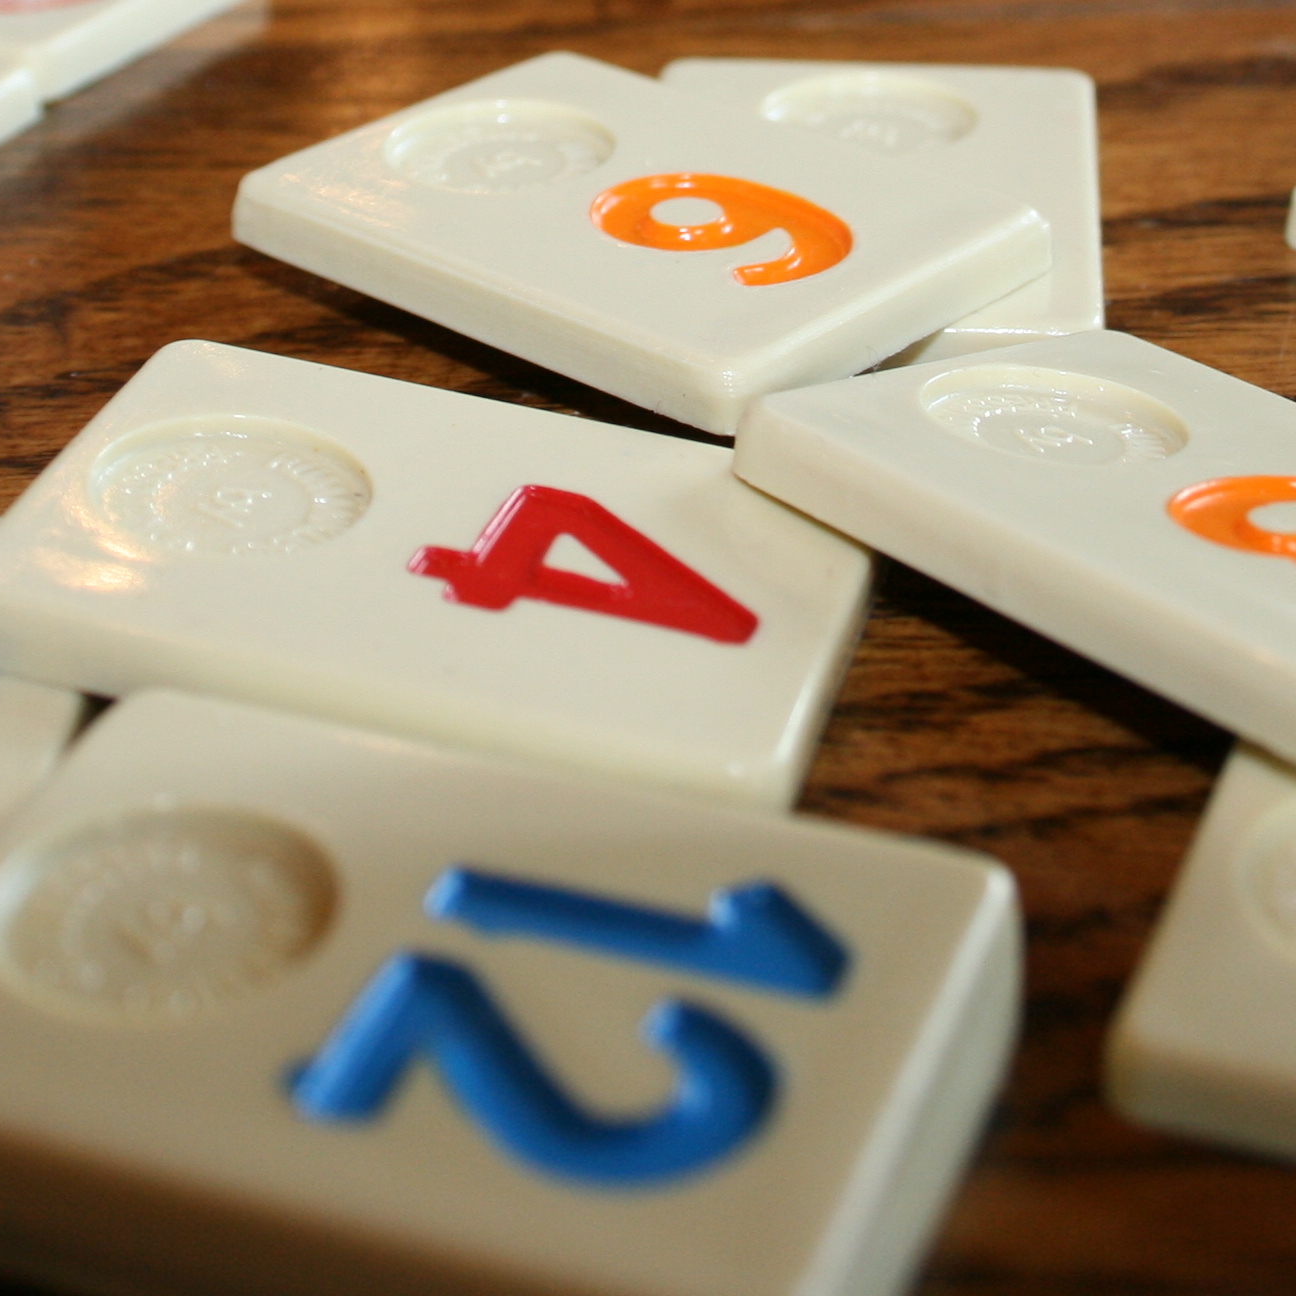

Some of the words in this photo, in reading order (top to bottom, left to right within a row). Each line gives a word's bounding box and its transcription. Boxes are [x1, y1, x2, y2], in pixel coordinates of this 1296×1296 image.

[590, 173, 854, 287] 6
[407, 484, 760, 646] 4
[284, 866, 852, 1191] 12
